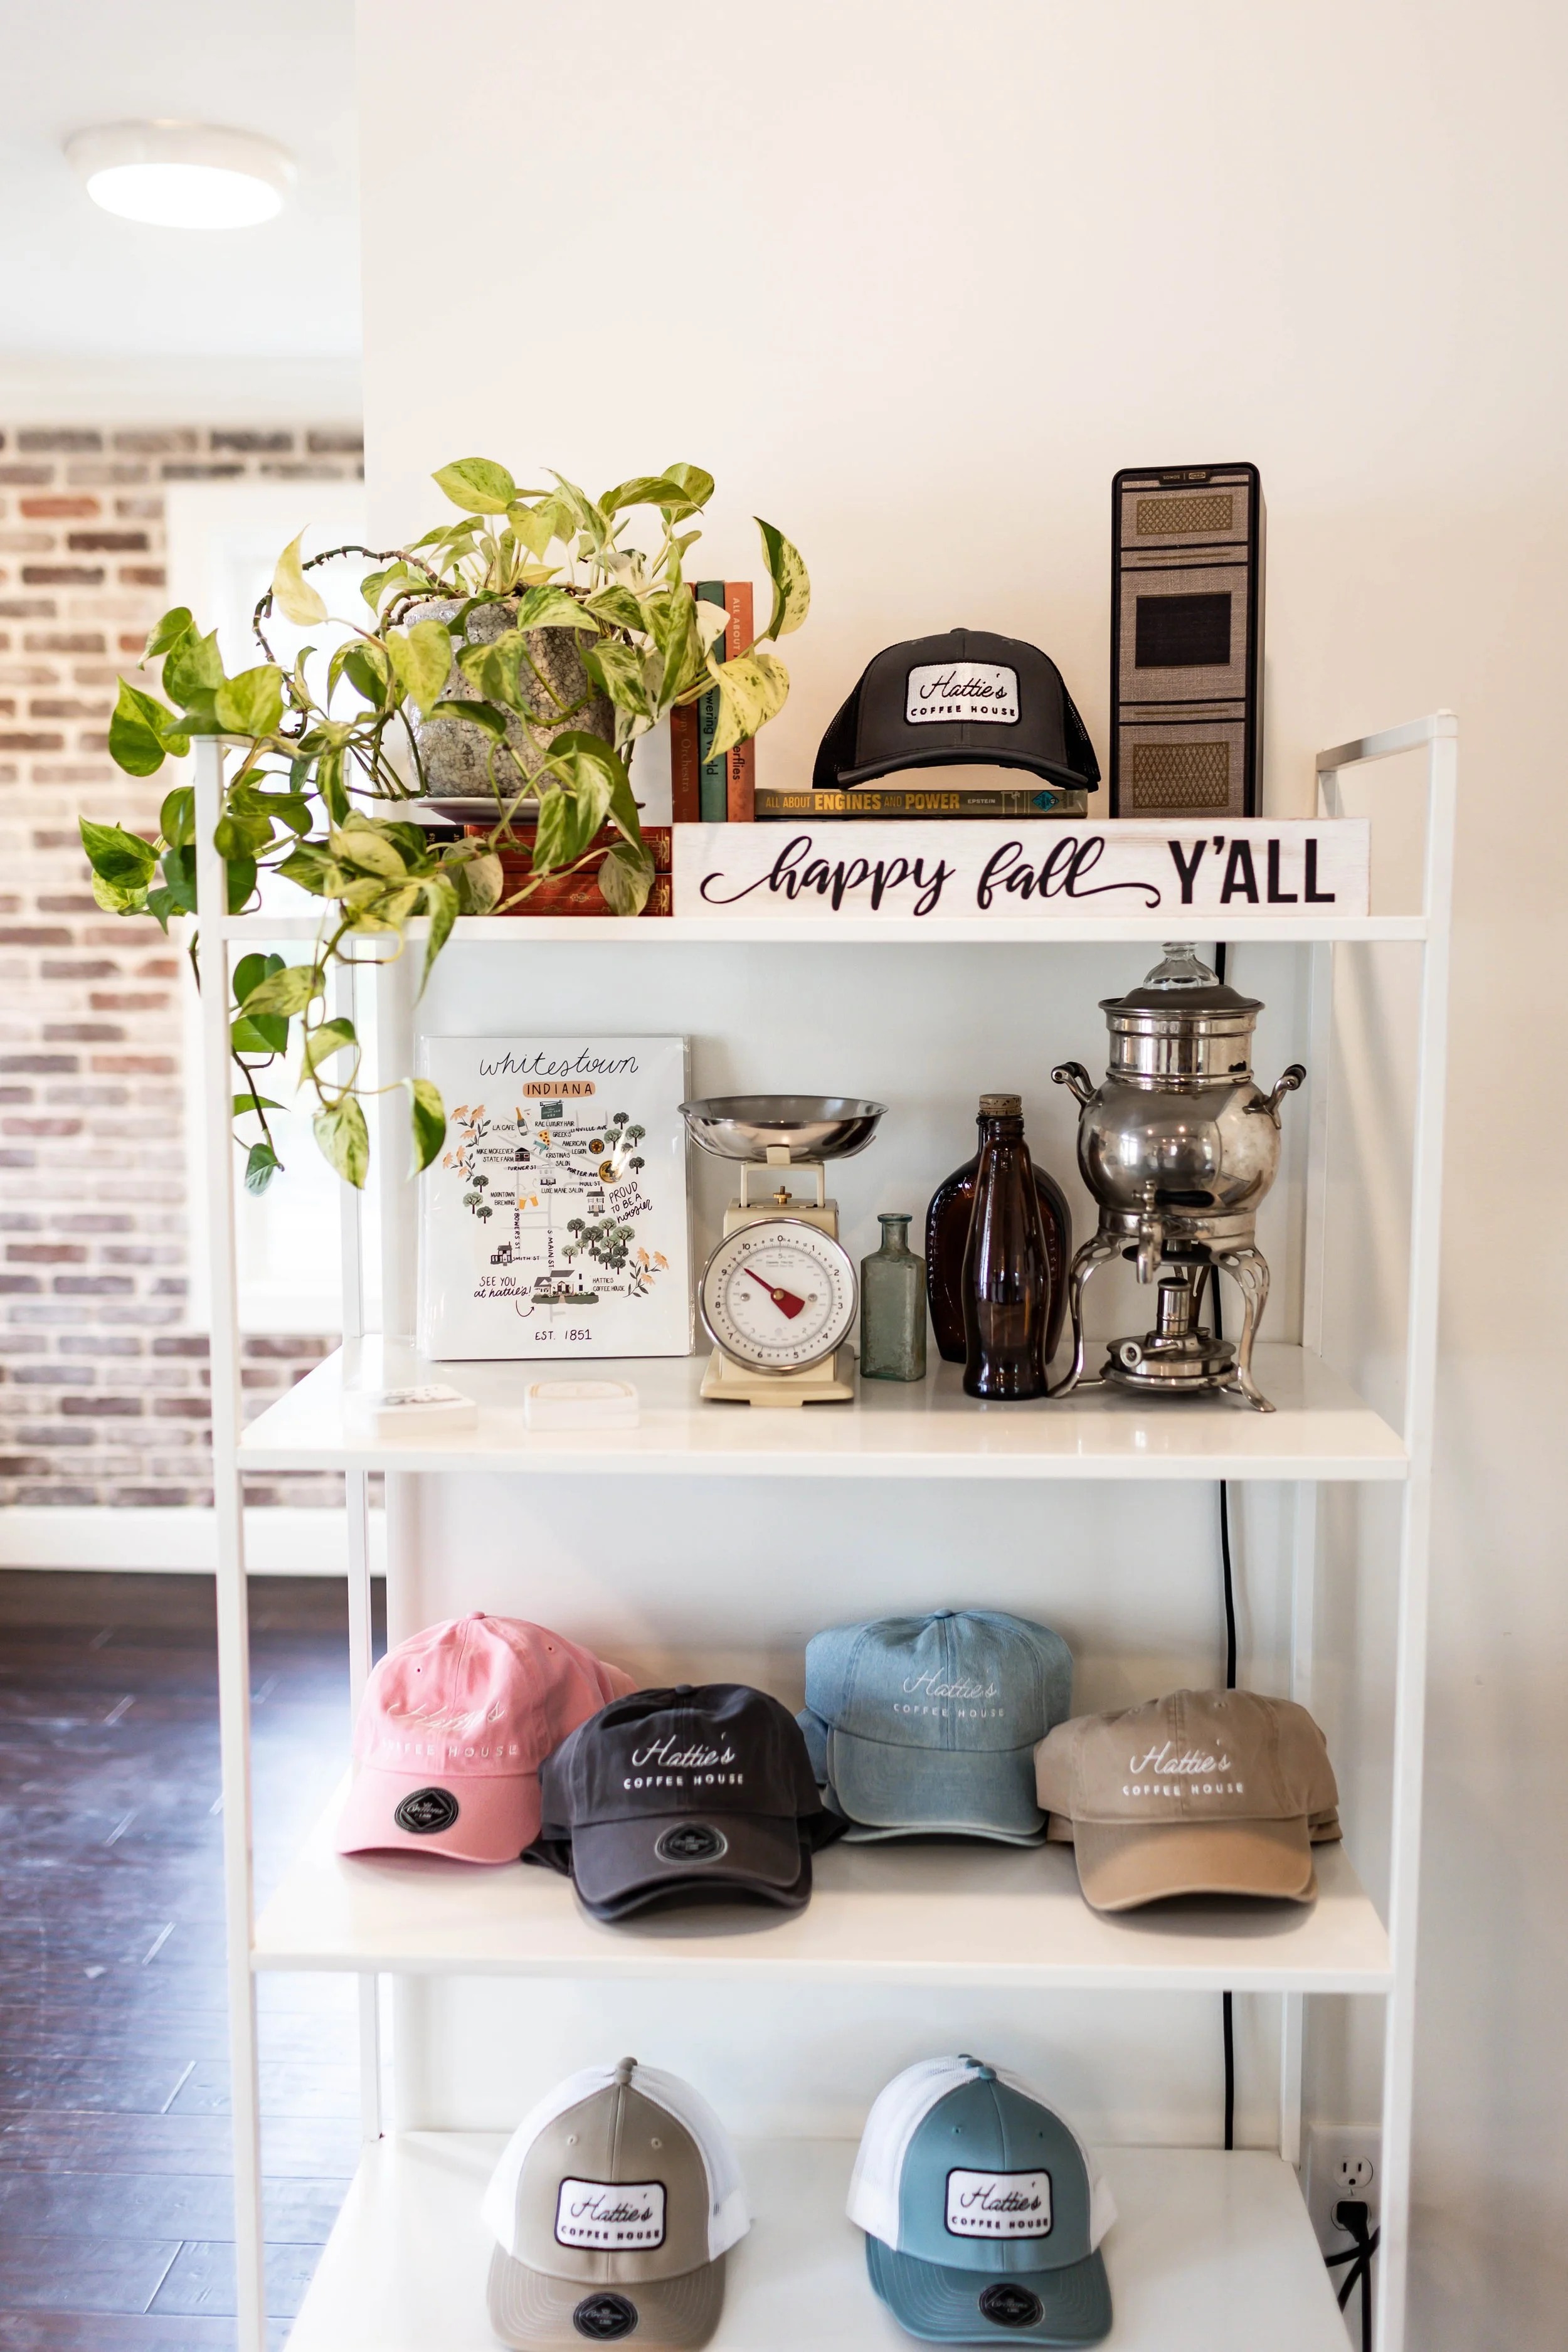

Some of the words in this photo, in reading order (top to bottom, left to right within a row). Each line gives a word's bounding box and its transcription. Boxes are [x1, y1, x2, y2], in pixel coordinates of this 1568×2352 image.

[920, 670, 1007, 699] Hattie's
[911, 705, 961, 716] COFFEE
[971, 706, 1015, 716] HOUSE
[681, 739, 692, 792] Orchestra
[733, 746, 745, 780] erflies
[765, 797, 779, 808] ALL
[783, 797, 810, 808] ABOUT
[815, 794, 881, 810] ENGINES
[884, 797, 902, 807] AND
[904, 794, 960, 810] POWER
[700, 835, 956, 916] happy
[977, 837, 1161, 909] fall
[1168, 835, 1335, 904] Y'ALL
[479, 1048, 638, 1076] whitestown
[527, 1084, 592, 1095] INDIANA
[567, 1167, 586, 1177] PORTER
[609, 1182, 637, 1204] PROUD
[611, 1204, 620, 1214] TO
[623, 1197, 634, 1209] BE
[635, 1194, 642, 1202] A
[548, 1259, 554, 1268] ST
[479, 1276, 496, 1286] SEE
[501, 1276, 516, 1286] YOU
[474, 1289, 486, 1298] at
[535, 1331, 556, 1340] EST.
[565, 1329, 592, 1341] 1851
[903, 1666, 997, 1698] Hattie's
[893, 1703, 948, 1717] COFFEE
[958, 1708, 1005, 1717] HOUSE
[448, 1745, 519, 1757] HOUSE
[632, 1732, 735, 1767] Hattie's
[1130, 1739, 1231, 1774] Hattie's
[623, 1776, 683, 1789] COFFEE
[694, 1774, 743, 1785] HOUSE
[1123, 1785, 1181, 1796] COFFEE
[1191, 1783, 1243, 1795] HOUSE
[960, 2181, 1041, 2212] Hattie's
[571, 2193, 653, 2222] Hattie's
[951, 2217, 1000, 2229] COFFEE
[1009, 2218, 1048, 2228] HOUSE
[561, 2226, 608, 2240] COFFEE
[617, 2230, 660, 2240] HOUSE
